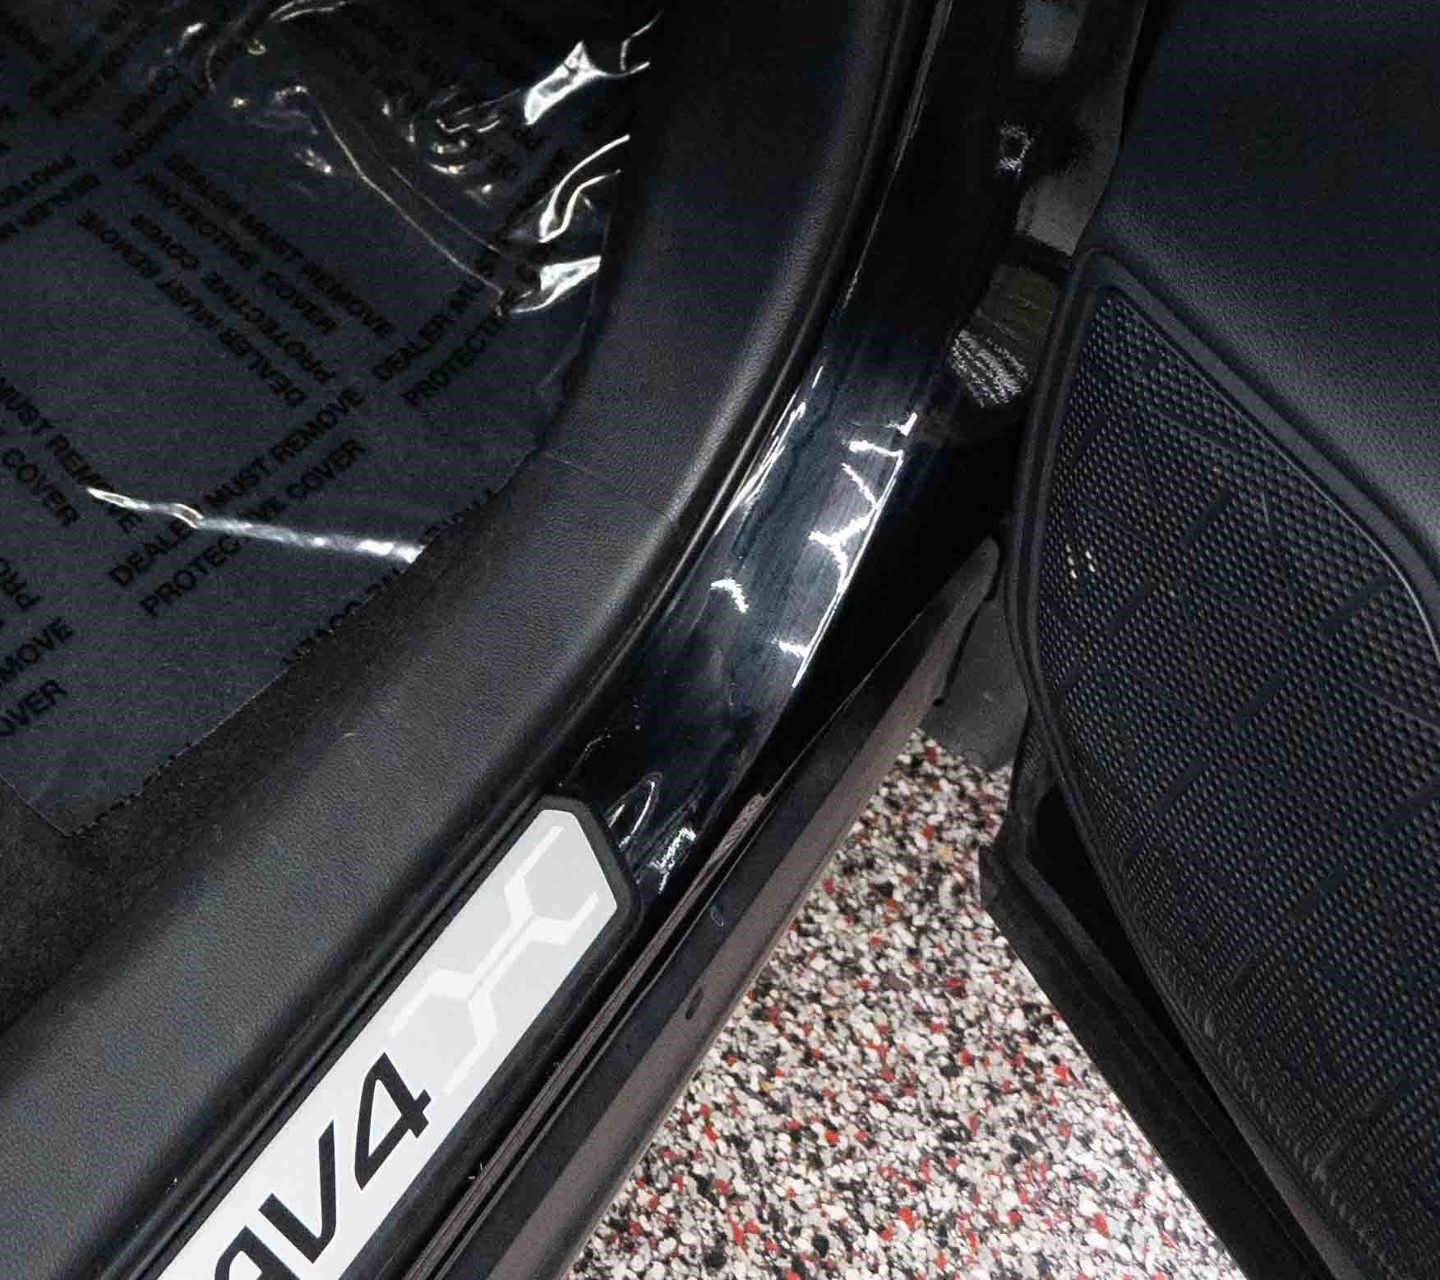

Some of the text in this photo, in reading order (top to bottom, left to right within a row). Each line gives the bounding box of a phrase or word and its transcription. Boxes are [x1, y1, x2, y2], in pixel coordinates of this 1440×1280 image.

[2, 447, 81, 528] COVER
[44, 433, 144, 535] REMVE
[107, 504, 202, 589] DEALE
[268, 385, 366, 465] REMOVE
[138, 496, 288, 619] PROTECVE
[286, 438, 367, 505] COVER
